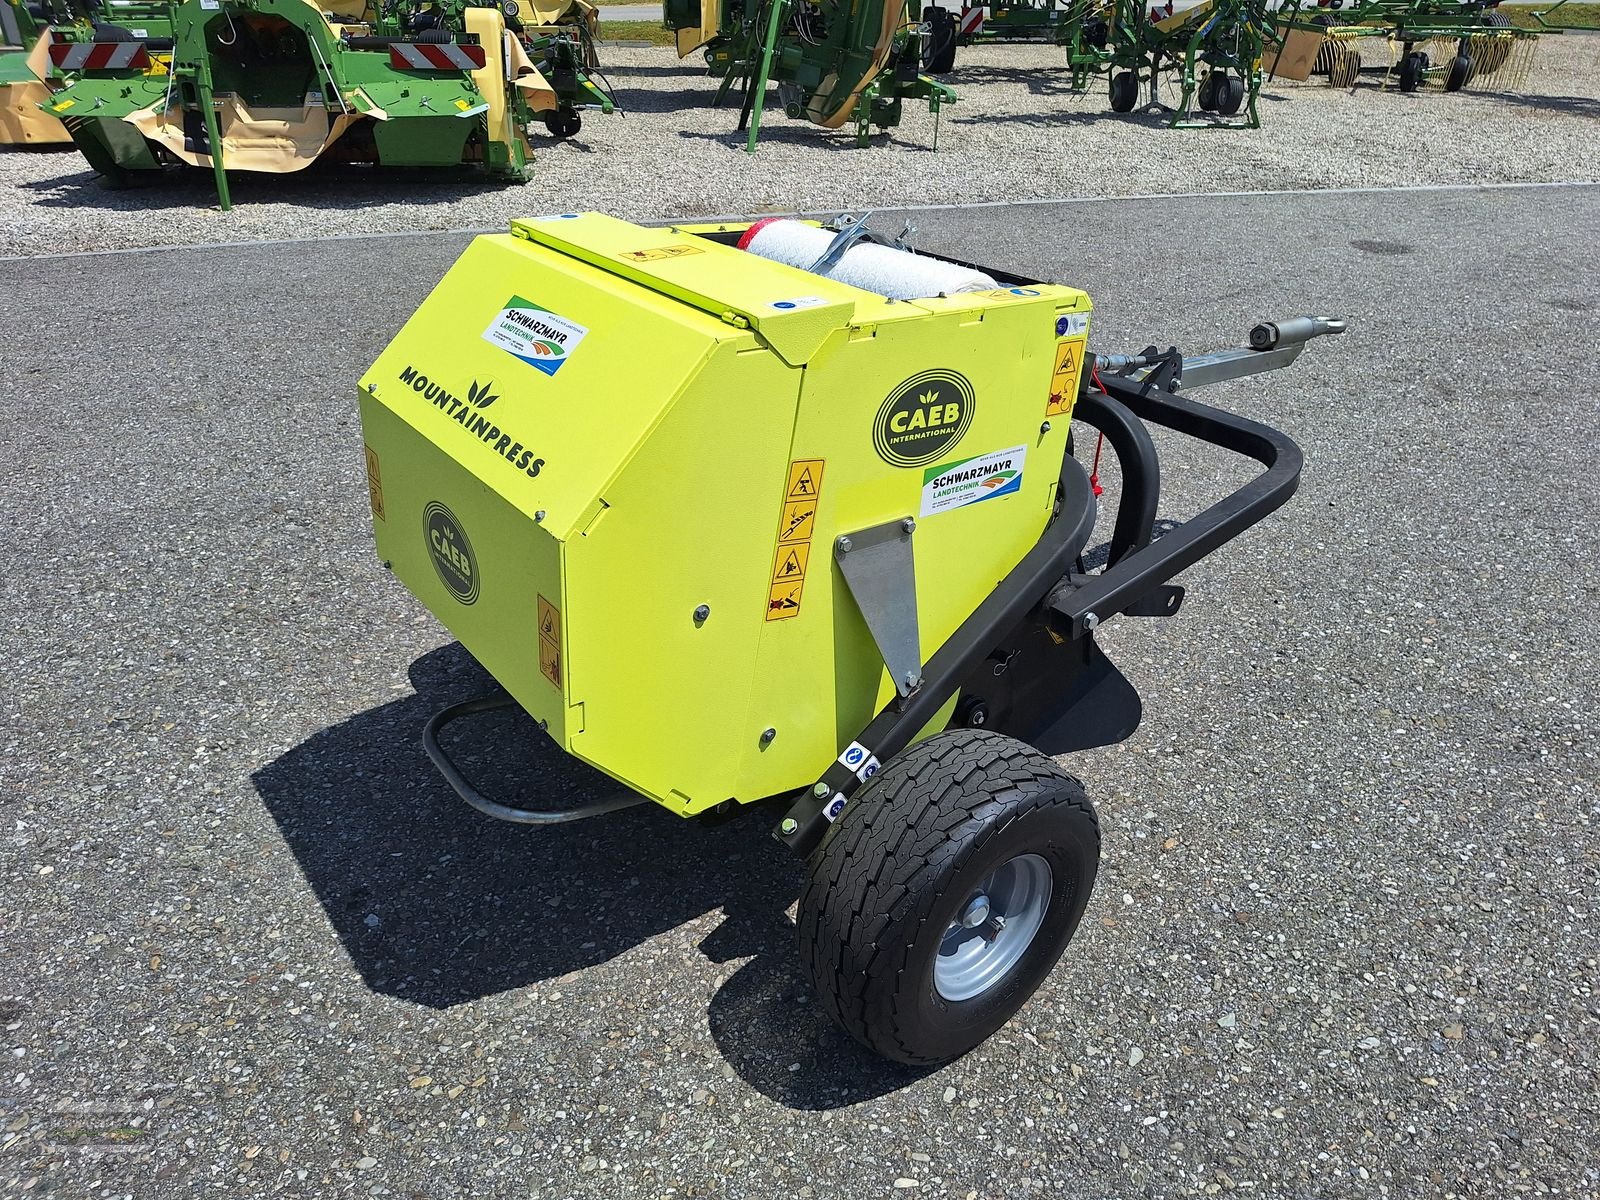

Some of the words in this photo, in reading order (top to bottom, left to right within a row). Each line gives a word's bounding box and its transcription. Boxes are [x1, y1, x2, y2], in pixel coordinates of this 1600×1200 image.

[500, 321, 535, 342] LANDTECHNIK
[506, 309, 568, 344] SCHWARZMAYR
[399, 366, 545, 477] MOUNTAINPRESS
[890, 402, 959, 433] CAEB
[890, 427, 955, 444] INTERNATIONAL
[932, 459, 1012, 489] SCHWARZMAYR
[933, 481, 980, 499] LANDTECHNIK
[431, 528, 471, 576] CAEB
